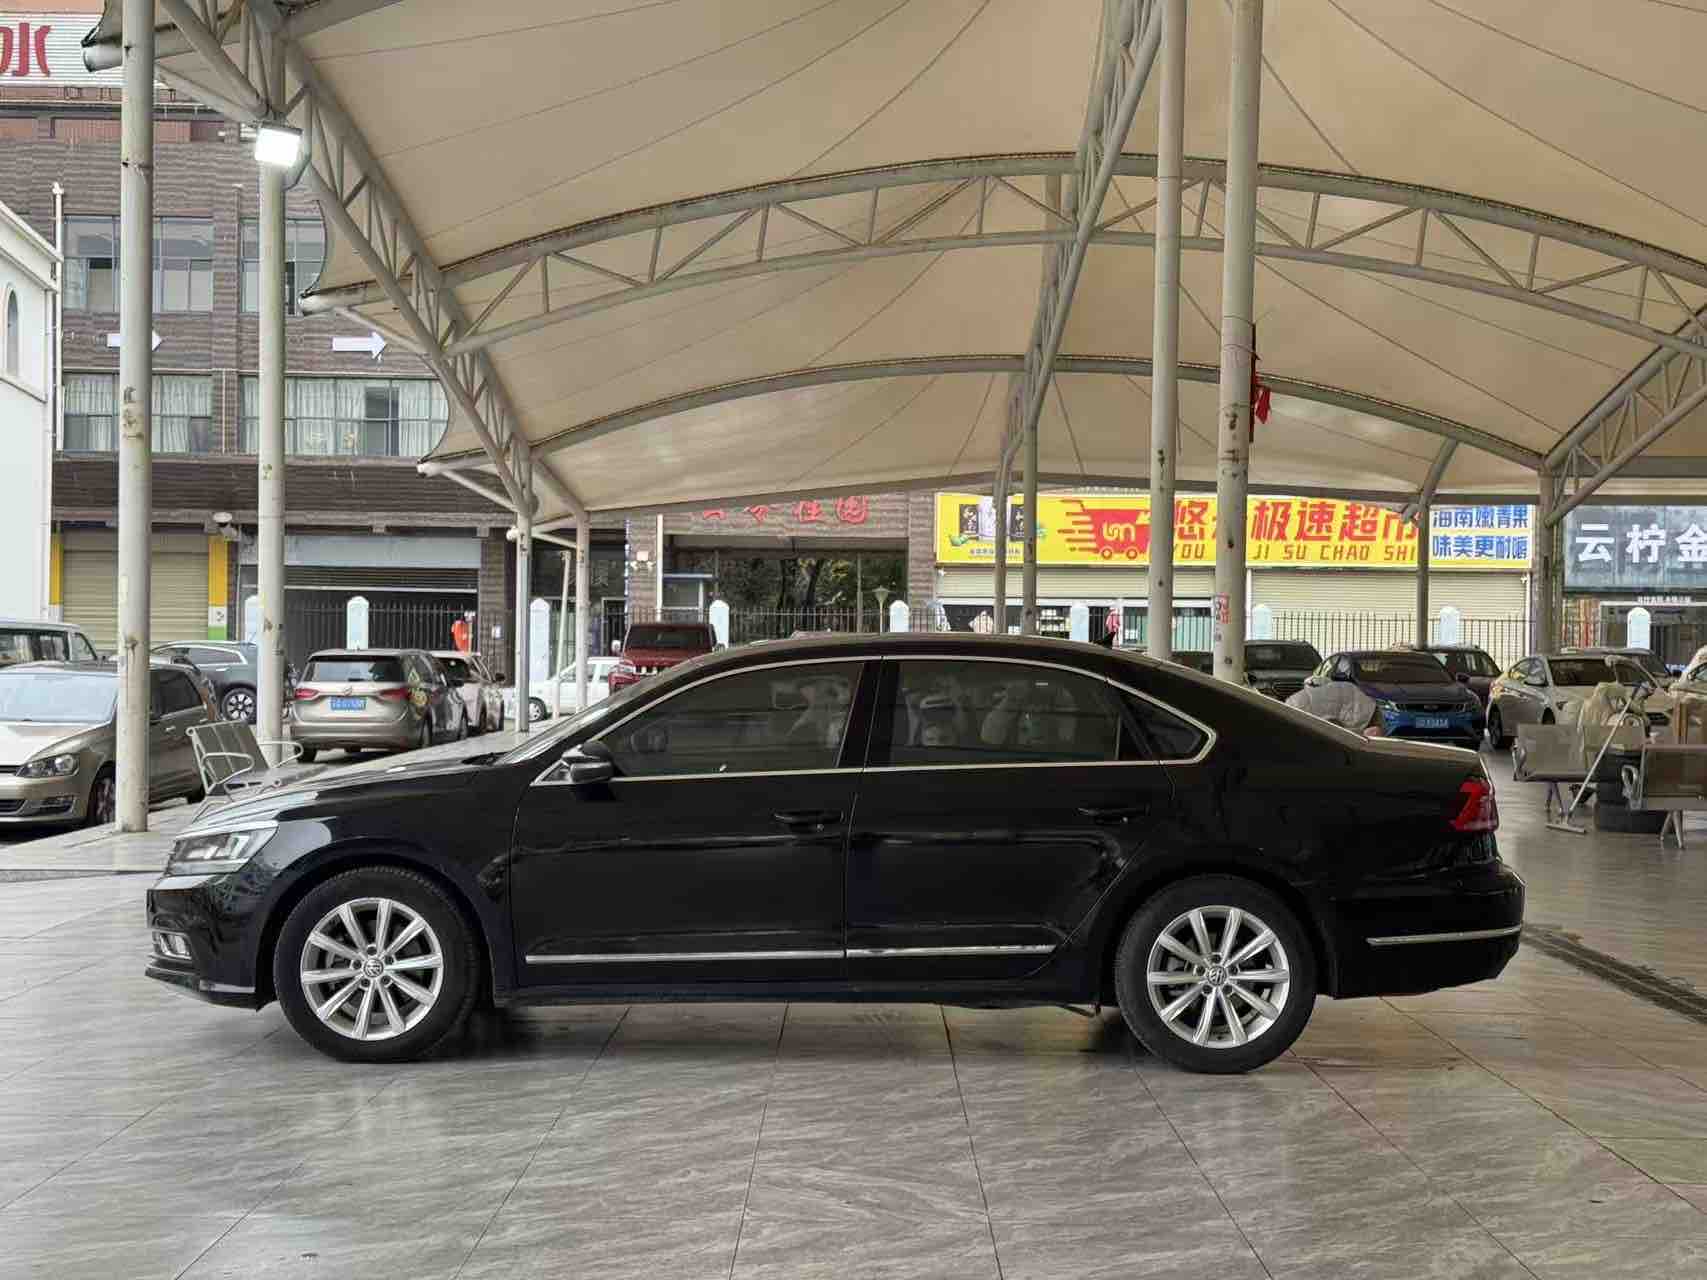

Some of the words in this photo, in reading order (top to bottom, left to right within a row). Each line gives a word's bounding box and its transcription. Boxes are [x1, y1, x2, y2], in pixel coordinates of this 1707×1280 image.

[1253, 544, 1270, 560] JI
[1283, 544, 1307, 560] SU
[1320, 545, 1370, 561] CHAO
[1384, 545, 1415, 561] SHI
